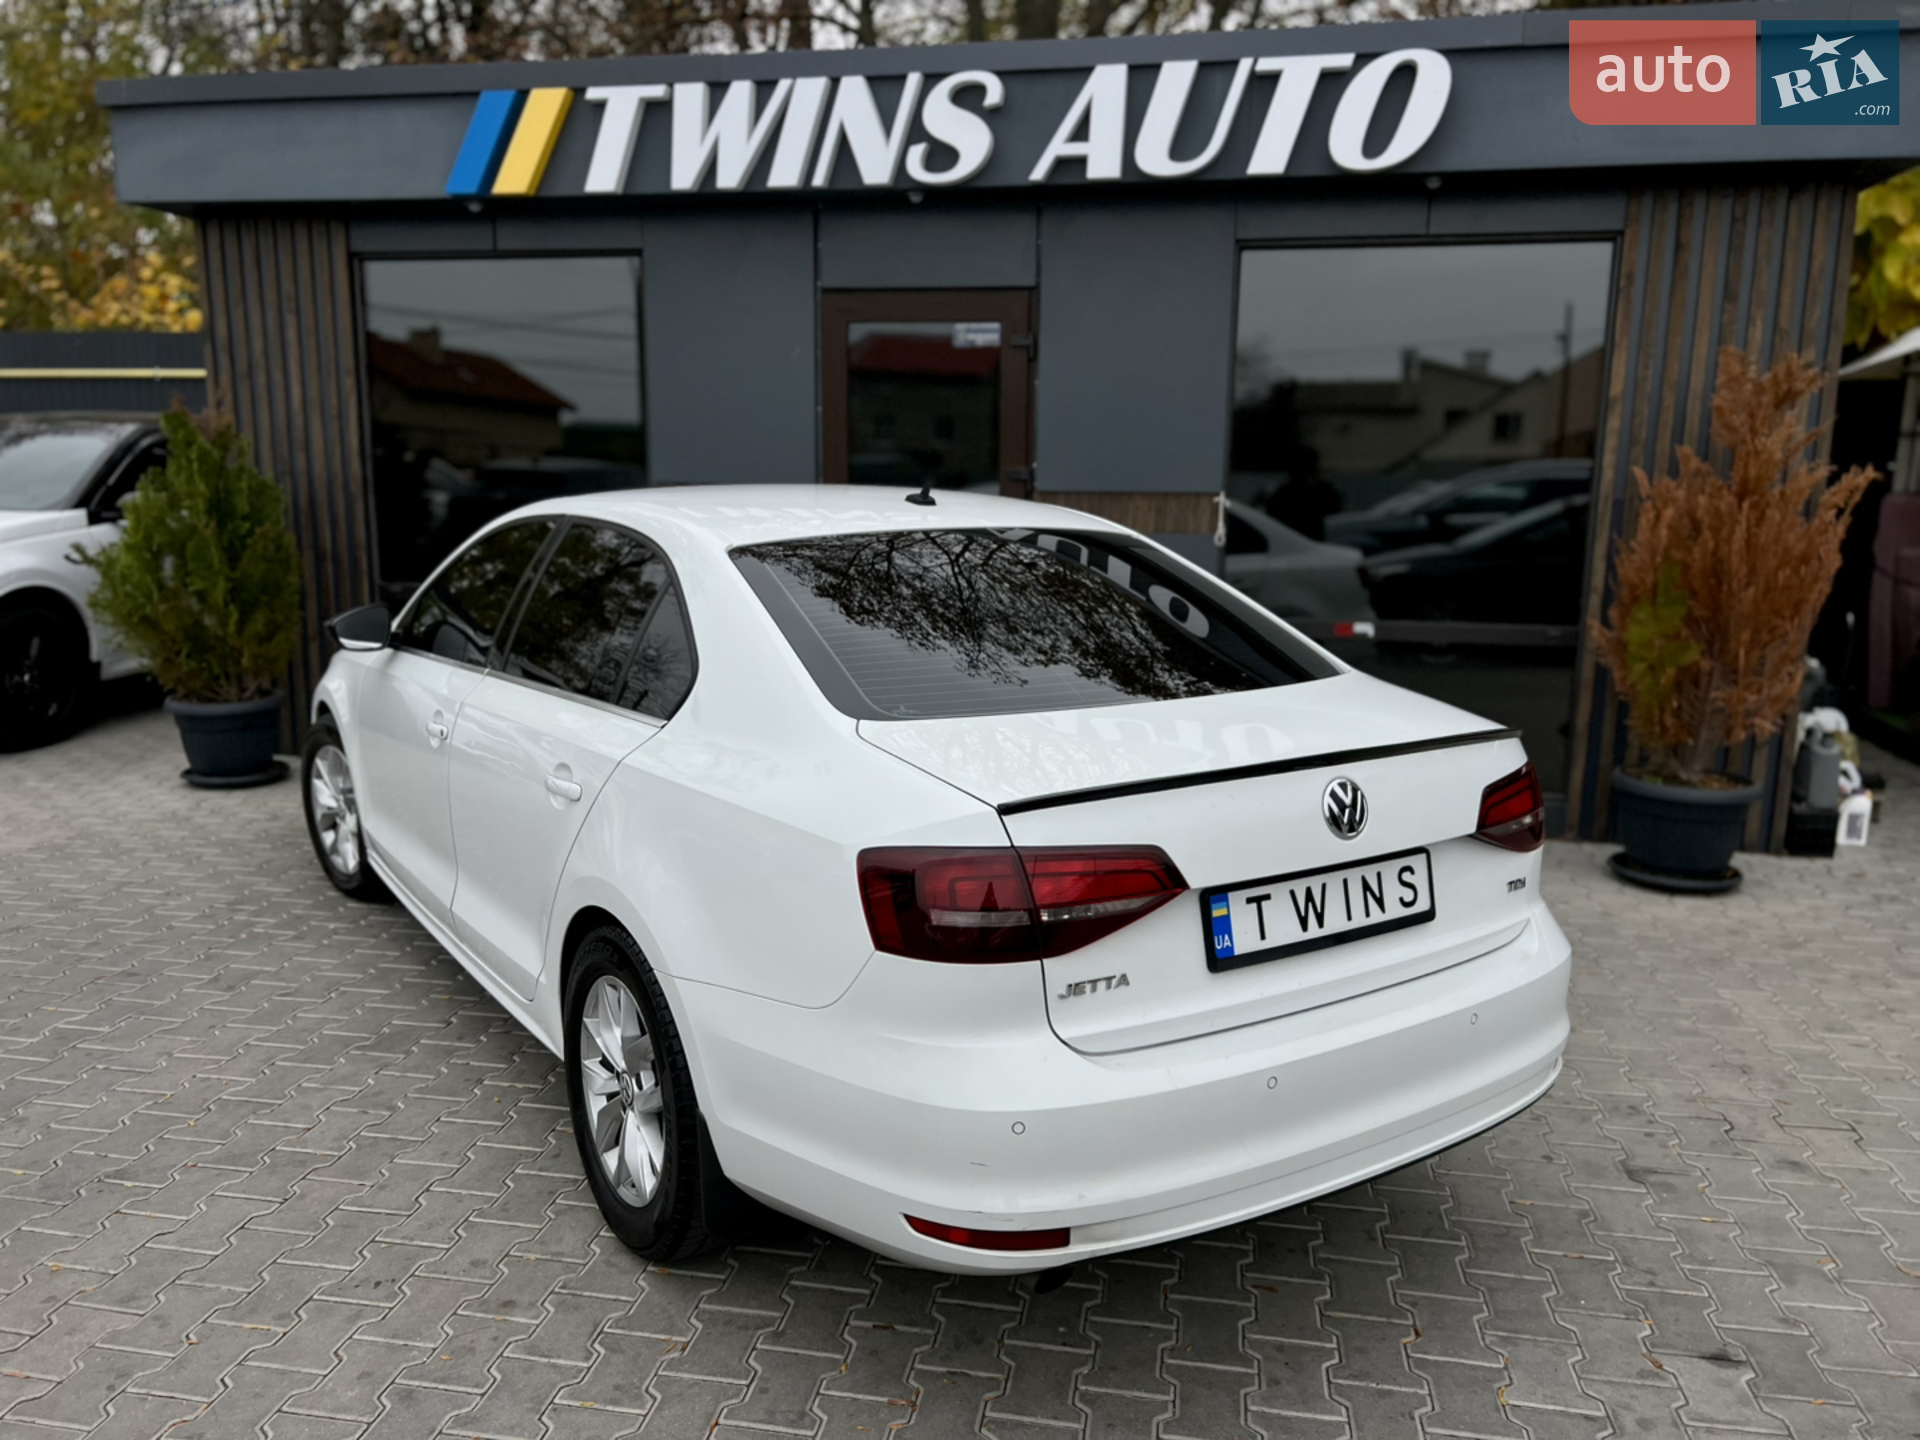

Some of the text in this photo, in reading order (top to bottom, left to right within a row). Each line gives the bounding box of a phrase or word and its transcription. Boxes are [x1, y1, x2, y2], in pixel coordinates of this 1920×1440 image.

[584, 48, 1453, 193] TWINS AUTO
[1214, 933, 1232, 950] UA
[1057, 973, 1130, 999] JETTA
